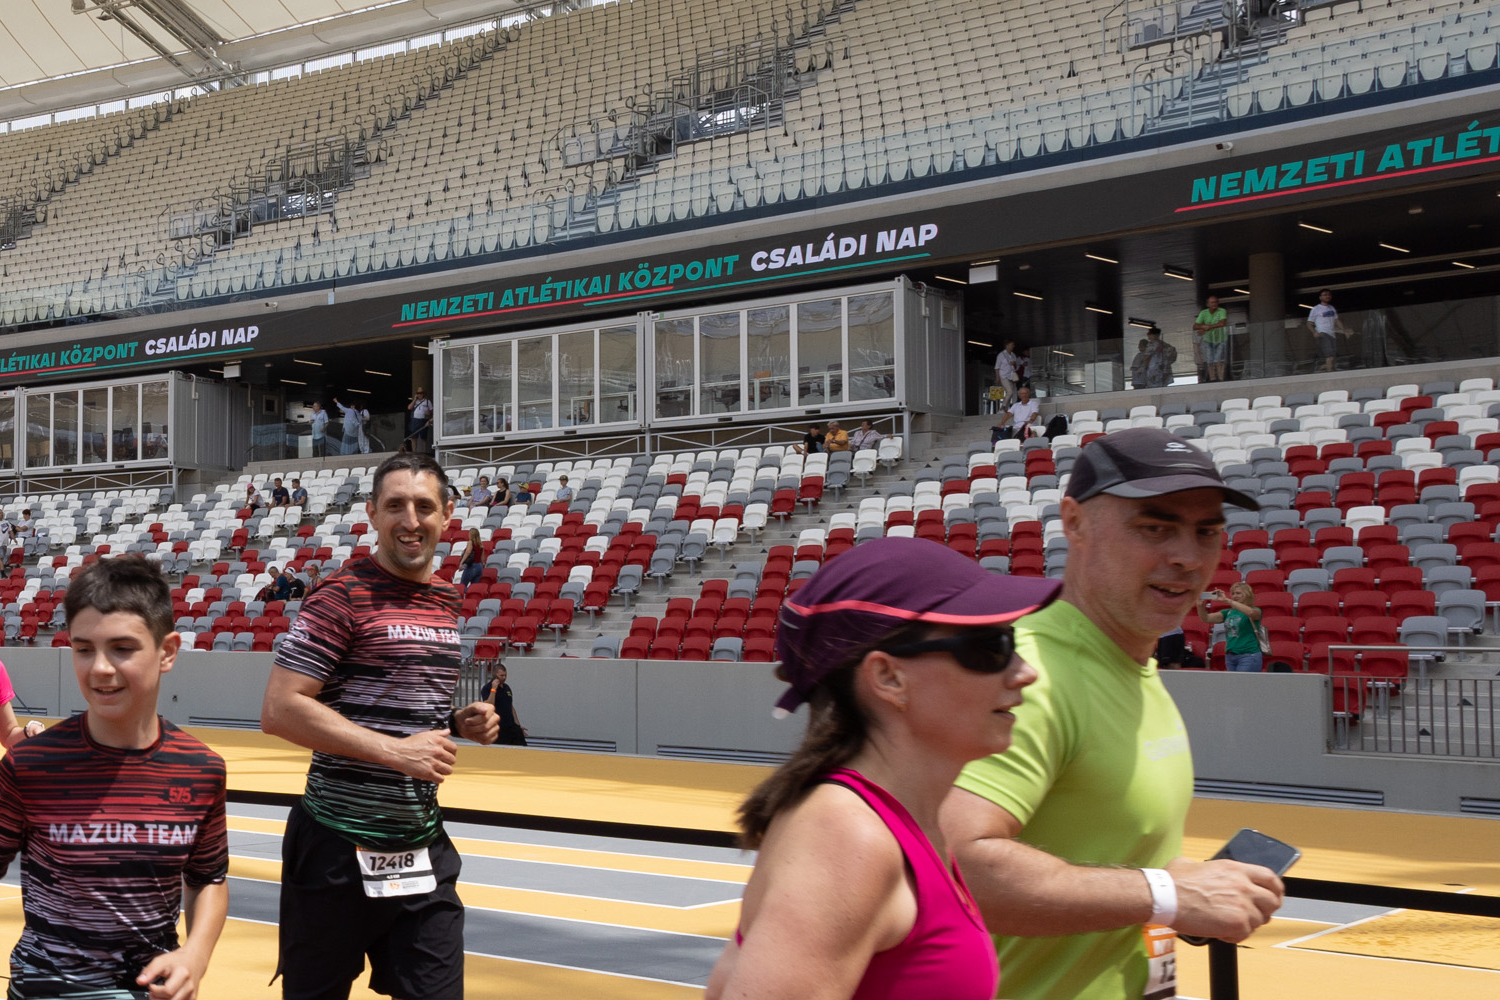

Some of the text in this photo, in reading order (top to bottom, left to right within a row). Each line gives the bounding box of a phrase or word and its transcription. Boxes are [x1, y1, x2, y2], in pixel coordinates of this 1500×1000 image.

[1190, 150, 1365, 203] NEMZETI
[400, 222, 938, 321] NEMZETI ATLÉTIKAI KÖZPONT CSALÁDI NAP
[59, 340, 138, 366] KÖZPONT
[144, 328, 216, 355] CSALÁDI
[221, 325, 259, 345] NAP
[387, 624, 438, 642] MAZUR
[169, 787, 192, 803] 575
[49, 823, 198, 845] MAZUR TEAM
[369, 853, 414, 871] 12418
